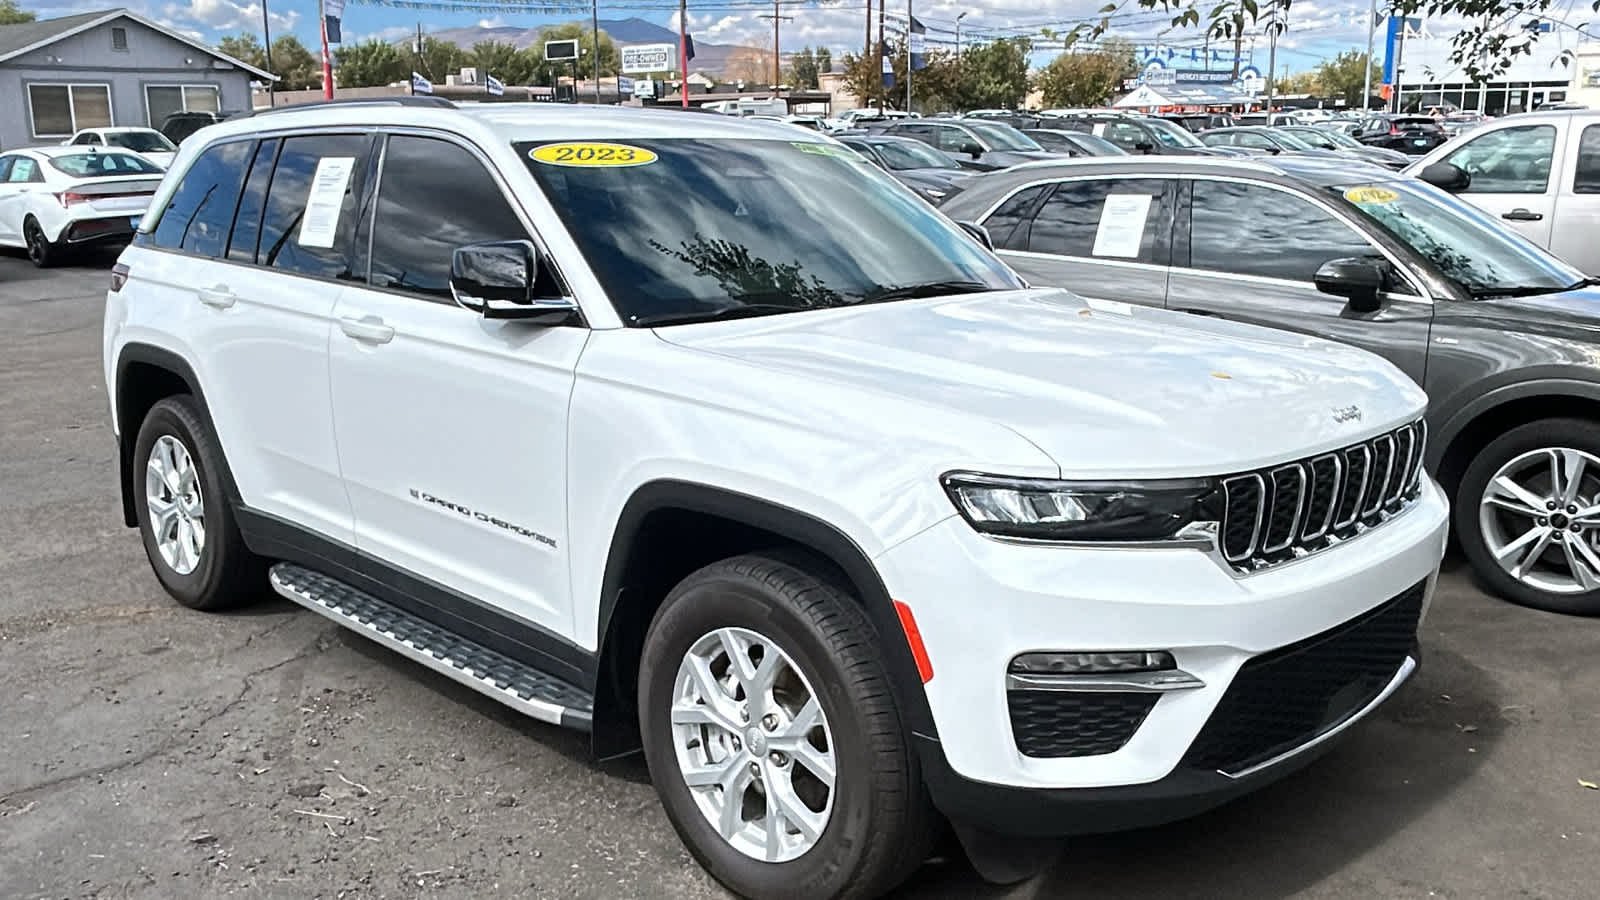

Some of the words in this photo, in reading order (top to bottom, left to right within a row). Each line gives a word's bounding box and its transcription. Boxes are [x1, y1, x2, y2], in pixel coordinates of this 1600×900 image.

[555, 147, 635, 161] 2023
[421, 491, 471, 516] GRAND
[473, 511, 558, 549] CHEROKEE
